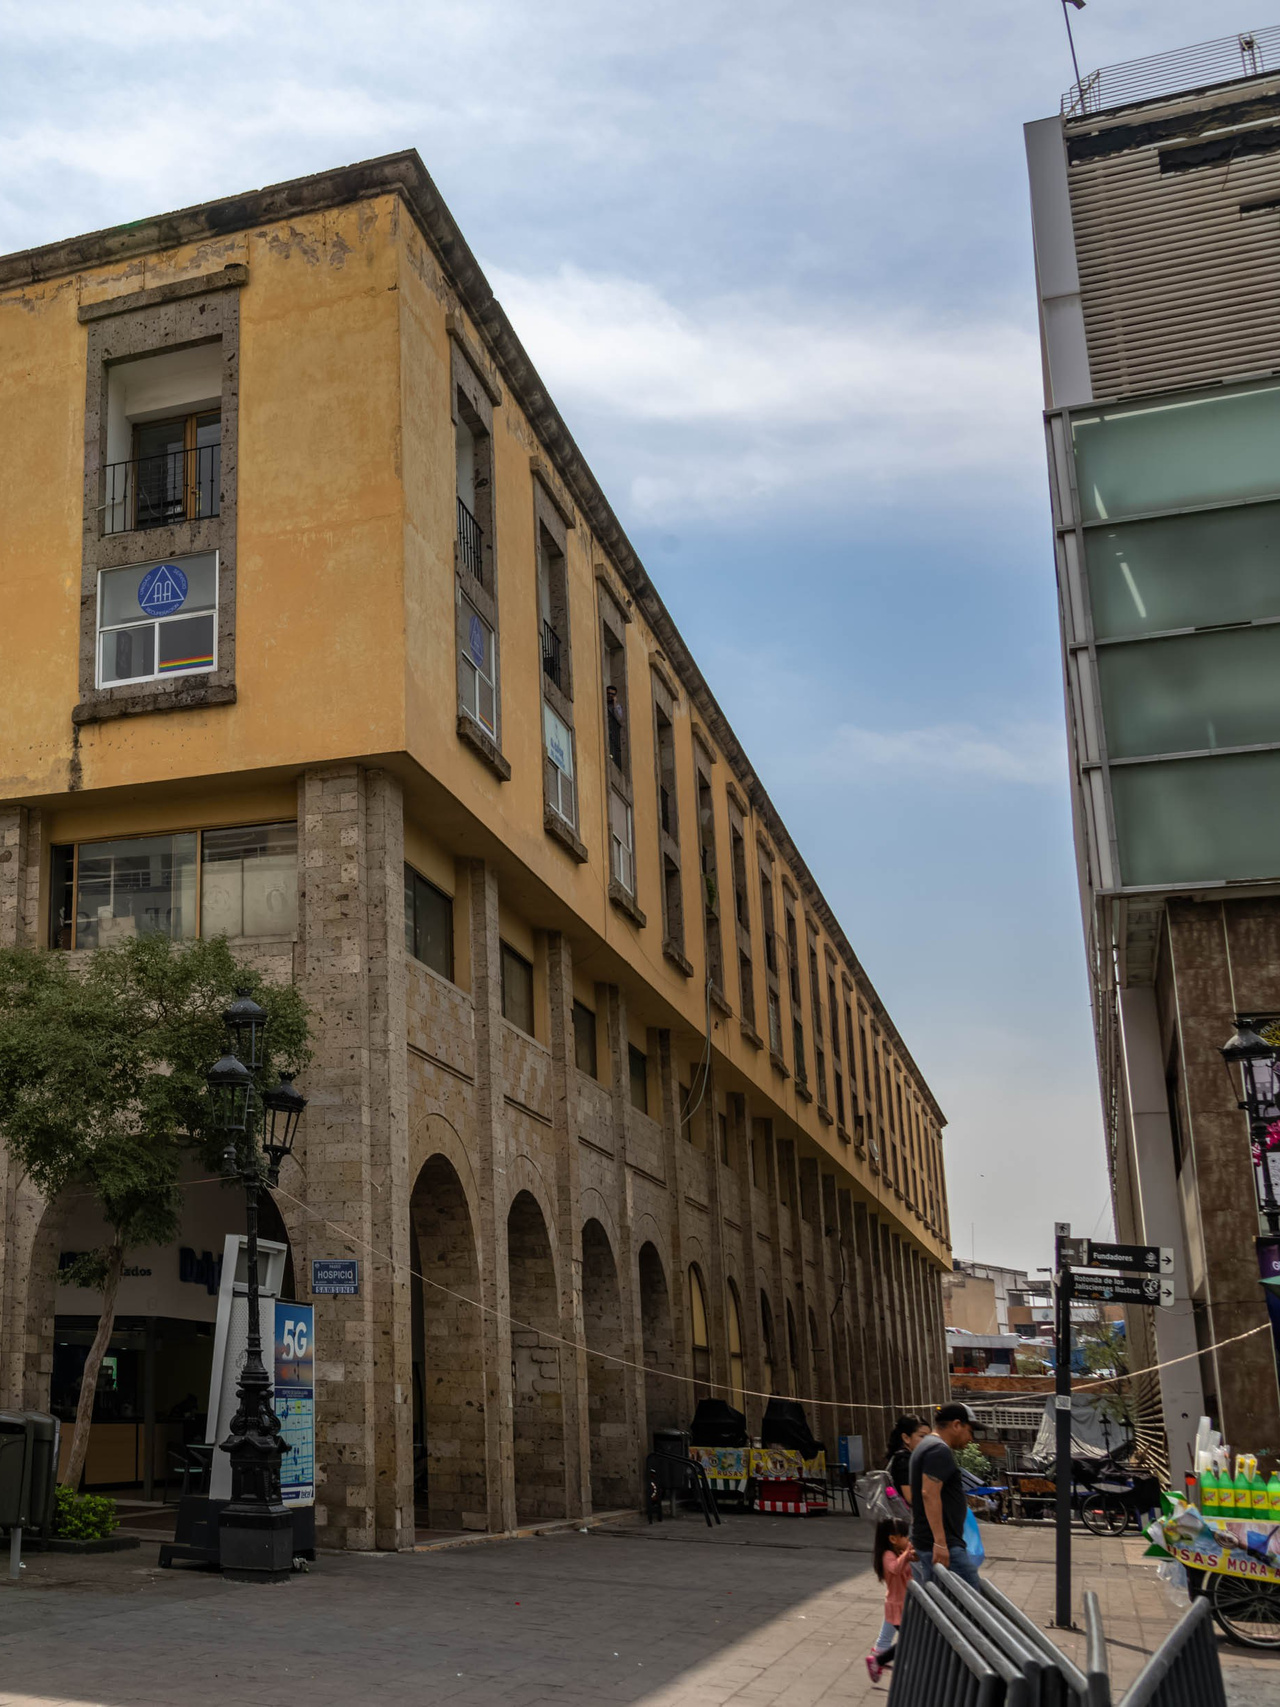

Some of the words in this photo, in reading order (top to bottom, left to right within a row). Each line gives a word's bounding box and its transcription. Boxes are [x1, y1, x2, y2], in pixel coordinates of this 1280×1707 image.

[153, 580, 172, 603] AA
[1093, 1252, 1133, 1262] Fundadores
[317, 1270, 354, 1279] HOSPICIO
[1073, 1275, 1102, 1284] Rotonda
[1104, 1277, 1113, 1285] de
[1114, 1278, 1125, 1286] los
[1074, 1283, 1114, 1292] Jaliscienses
[1115, 1286, 1141, 1295] Ilustres
[282, 1320, 308, 1360] 5G
[1227, 1557, 1267, 1576] MORA
